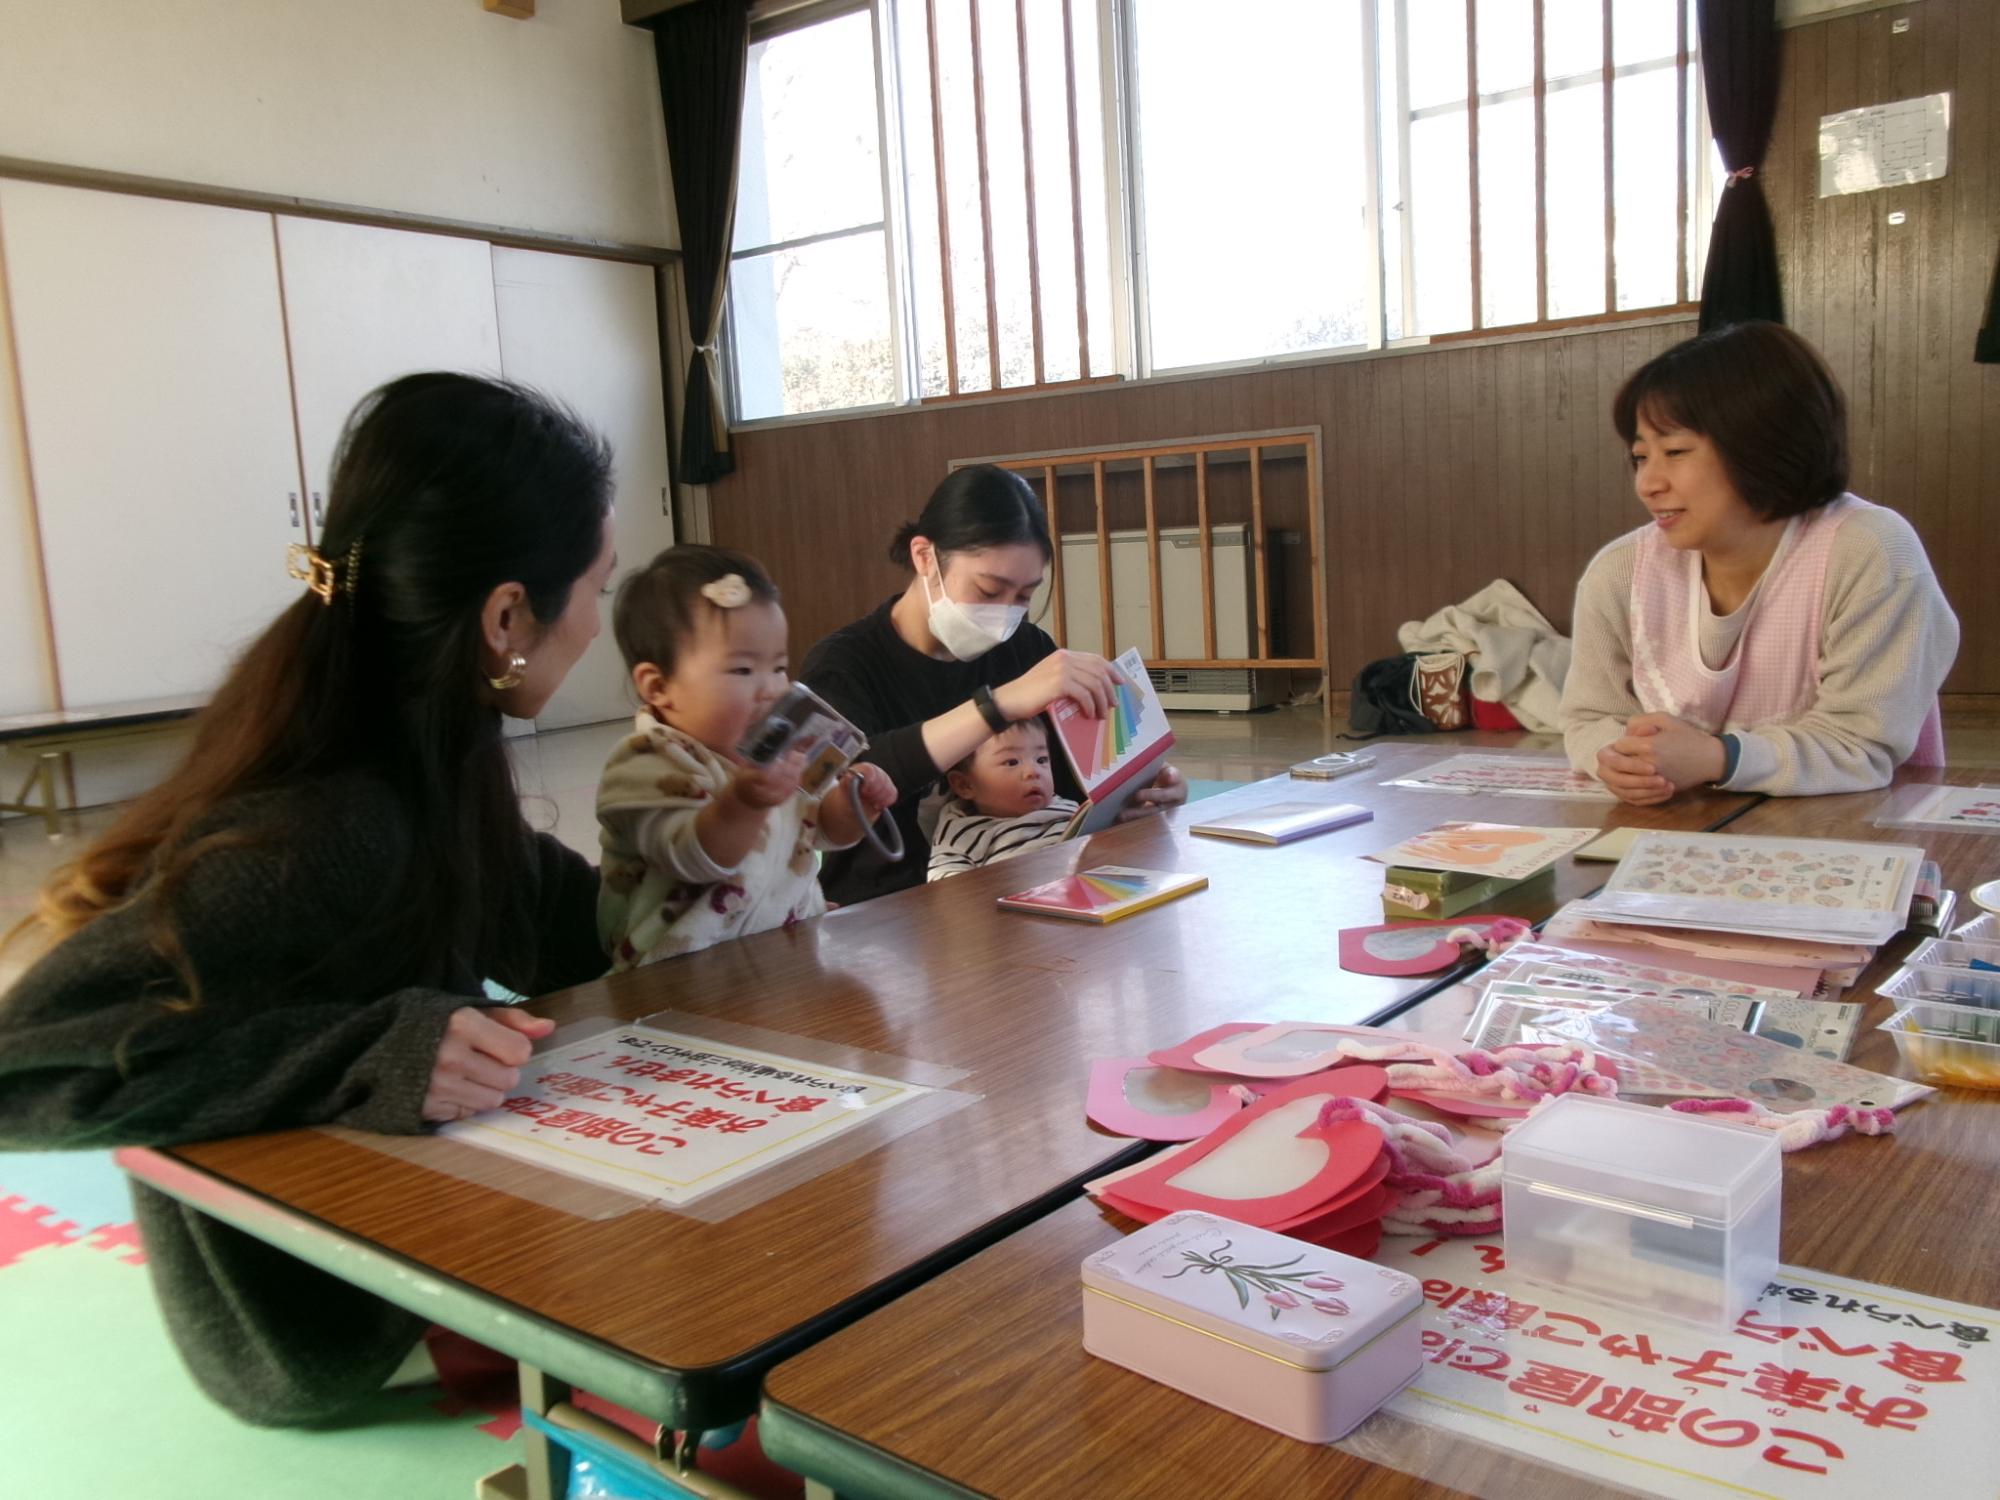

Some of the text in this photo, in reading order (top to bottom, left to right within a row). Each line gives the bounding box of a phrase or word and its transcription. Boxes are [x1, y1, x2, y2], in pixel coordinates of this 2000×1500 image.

[500, 1096, 687, 1155] この部屋では
[536, 1072, 768, 1133] お菓子やご飯は
[1422, 1279, 1928, 1431] お菓子やご飯は
[1422, 1331, 1845, 1475] この部屋では
